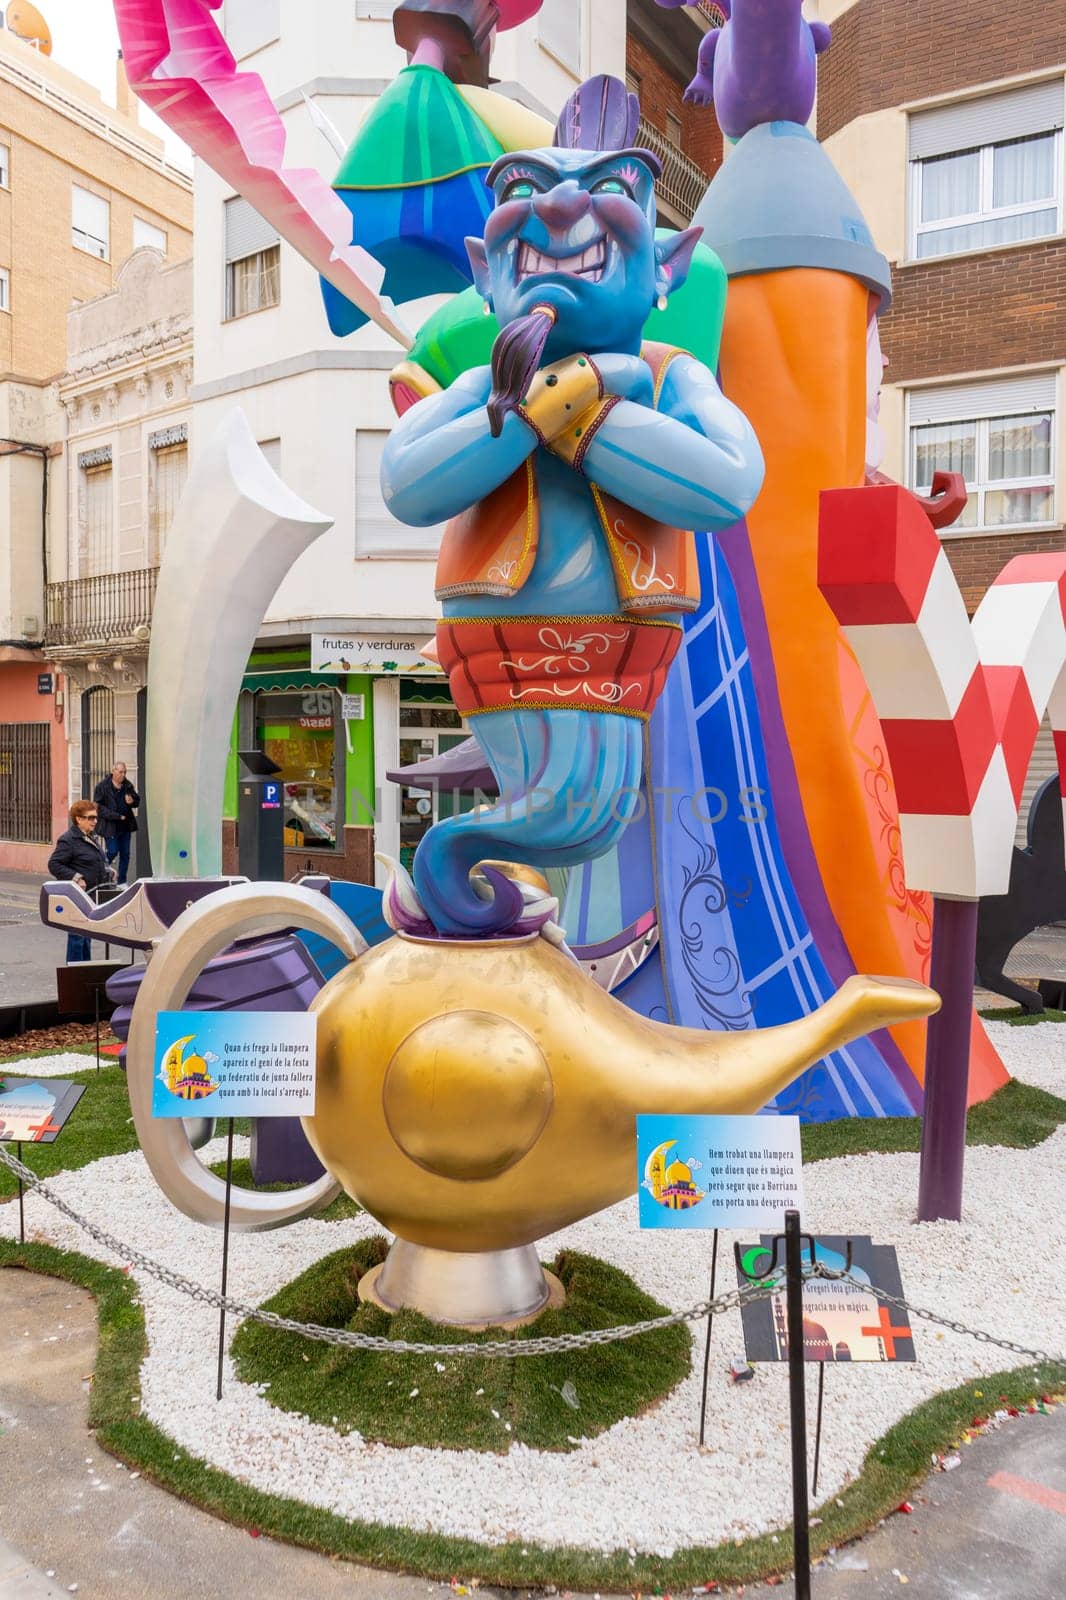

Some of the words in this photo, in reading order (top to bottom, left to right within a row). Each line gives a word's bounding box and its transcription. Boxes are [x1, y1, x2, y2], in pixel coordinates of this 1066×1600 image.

[322, 638, 354, 649] frutas
[358, 642, 364, 651] y
[367, 640, 415, 650] verduras
[267, 785, 276, 800] P
[225, 1043, 240, 1054] Quan
[243, 1043, 250, 1052] és
[253, 1043, 269, 1054] frega
[272, 1043, 277, 1052] la
[280, 1043, 309, 1054] llampera
[223, 1058, 248, 1069] apareix
[250, 1058, 256, 1066] el
[259, 1059, 272, 1068] geni
[275, 1058, 282, 1066] de
[285, 1058, 290, 1066] la
[293, 1058, 309, 1066] festa
[229, 1073, 259, 1081] federatiu
[262, 1073, 269, 1081] de
[272, 1073, 288, 1083] junta
[291, 1073, 312, 1081] fallera
[219, 1089, 235, 1099] quan
[237, 1088, 250, 1096] amb
[253, 1088, 259, 1096] la
[262, 1088, 277, 1096] local
[280, 1088, 311, 1098] s'arregla.
[709, 1149, 723, 1158] Hem
[726, 1149, 747, 1158] trobat
[764, 1149, 793, 1160] llampera
[711, 1167, 723, 1176] que
[725, 1165, 744, 1174] diuen
[747, 1167, 758, 1176] que
[761, 1165, 768, 1174] és
[770, 1165, 793, 1176] màgica
[708, 1181, 724, 1192] però
[727, 1183, 745, 1192] segur
[747, 1183, 759, 1192] que
[767, 1181, 797, 1190] Borriana
[726, 1198, 744, 1208] porta
[761, 1197, 796, 1209] desgracia.
[806, 1283, 830, 1294] Gregori
[831, 1283, 843, 1292] feia
[839, 1301, 845, 1311] és
